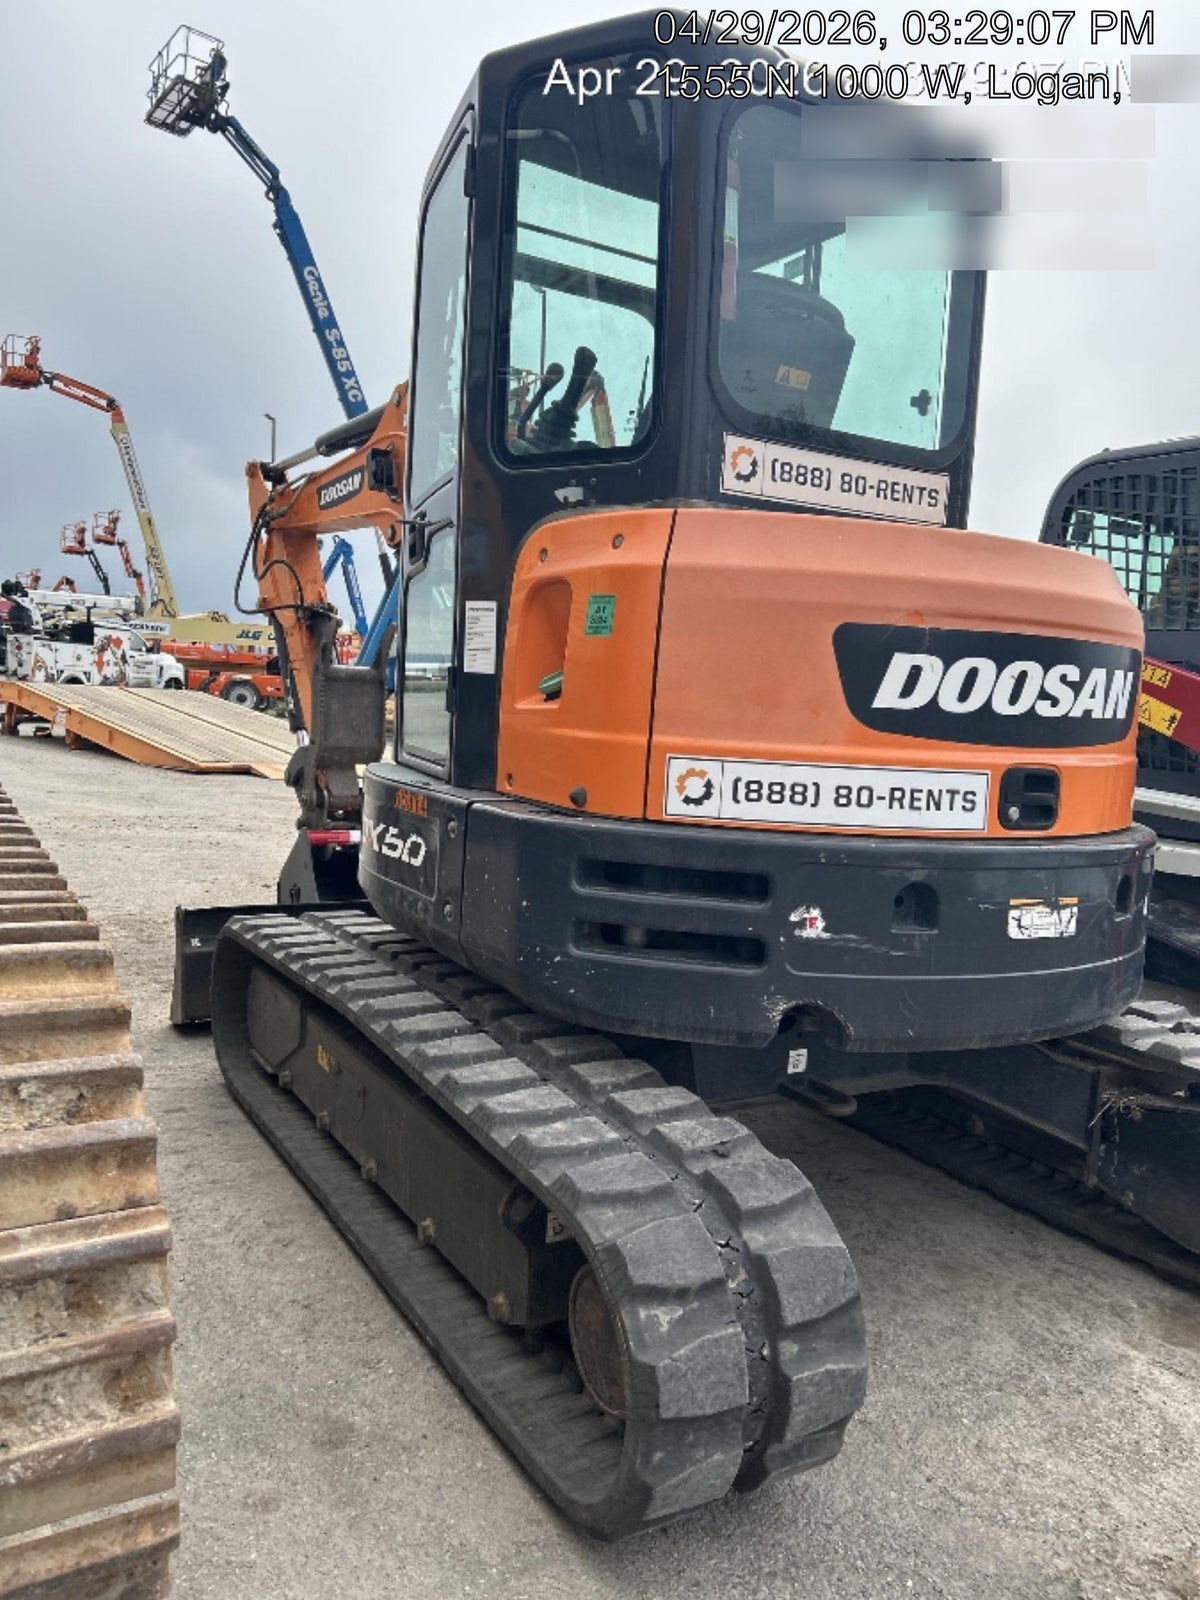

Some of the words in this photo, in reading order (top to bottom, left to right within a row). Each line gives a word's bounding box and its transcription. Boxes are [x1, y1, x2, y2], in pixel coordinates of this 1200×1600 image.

[304, 265, 330, 319] Genie
[325, 327, 352, 372] S-85
[341, 376, 363, 403] XC
[319, 472, 362, 506] DOOSAN
[770, 457, 832, 491] (888)
[839, 470, 941, 508] 80-RENTS
[871, 651, 1135, 720] DOOSAN
[731, 776, 821, 809] (888)
[833, 785, 979, 813] 80-RENTS
